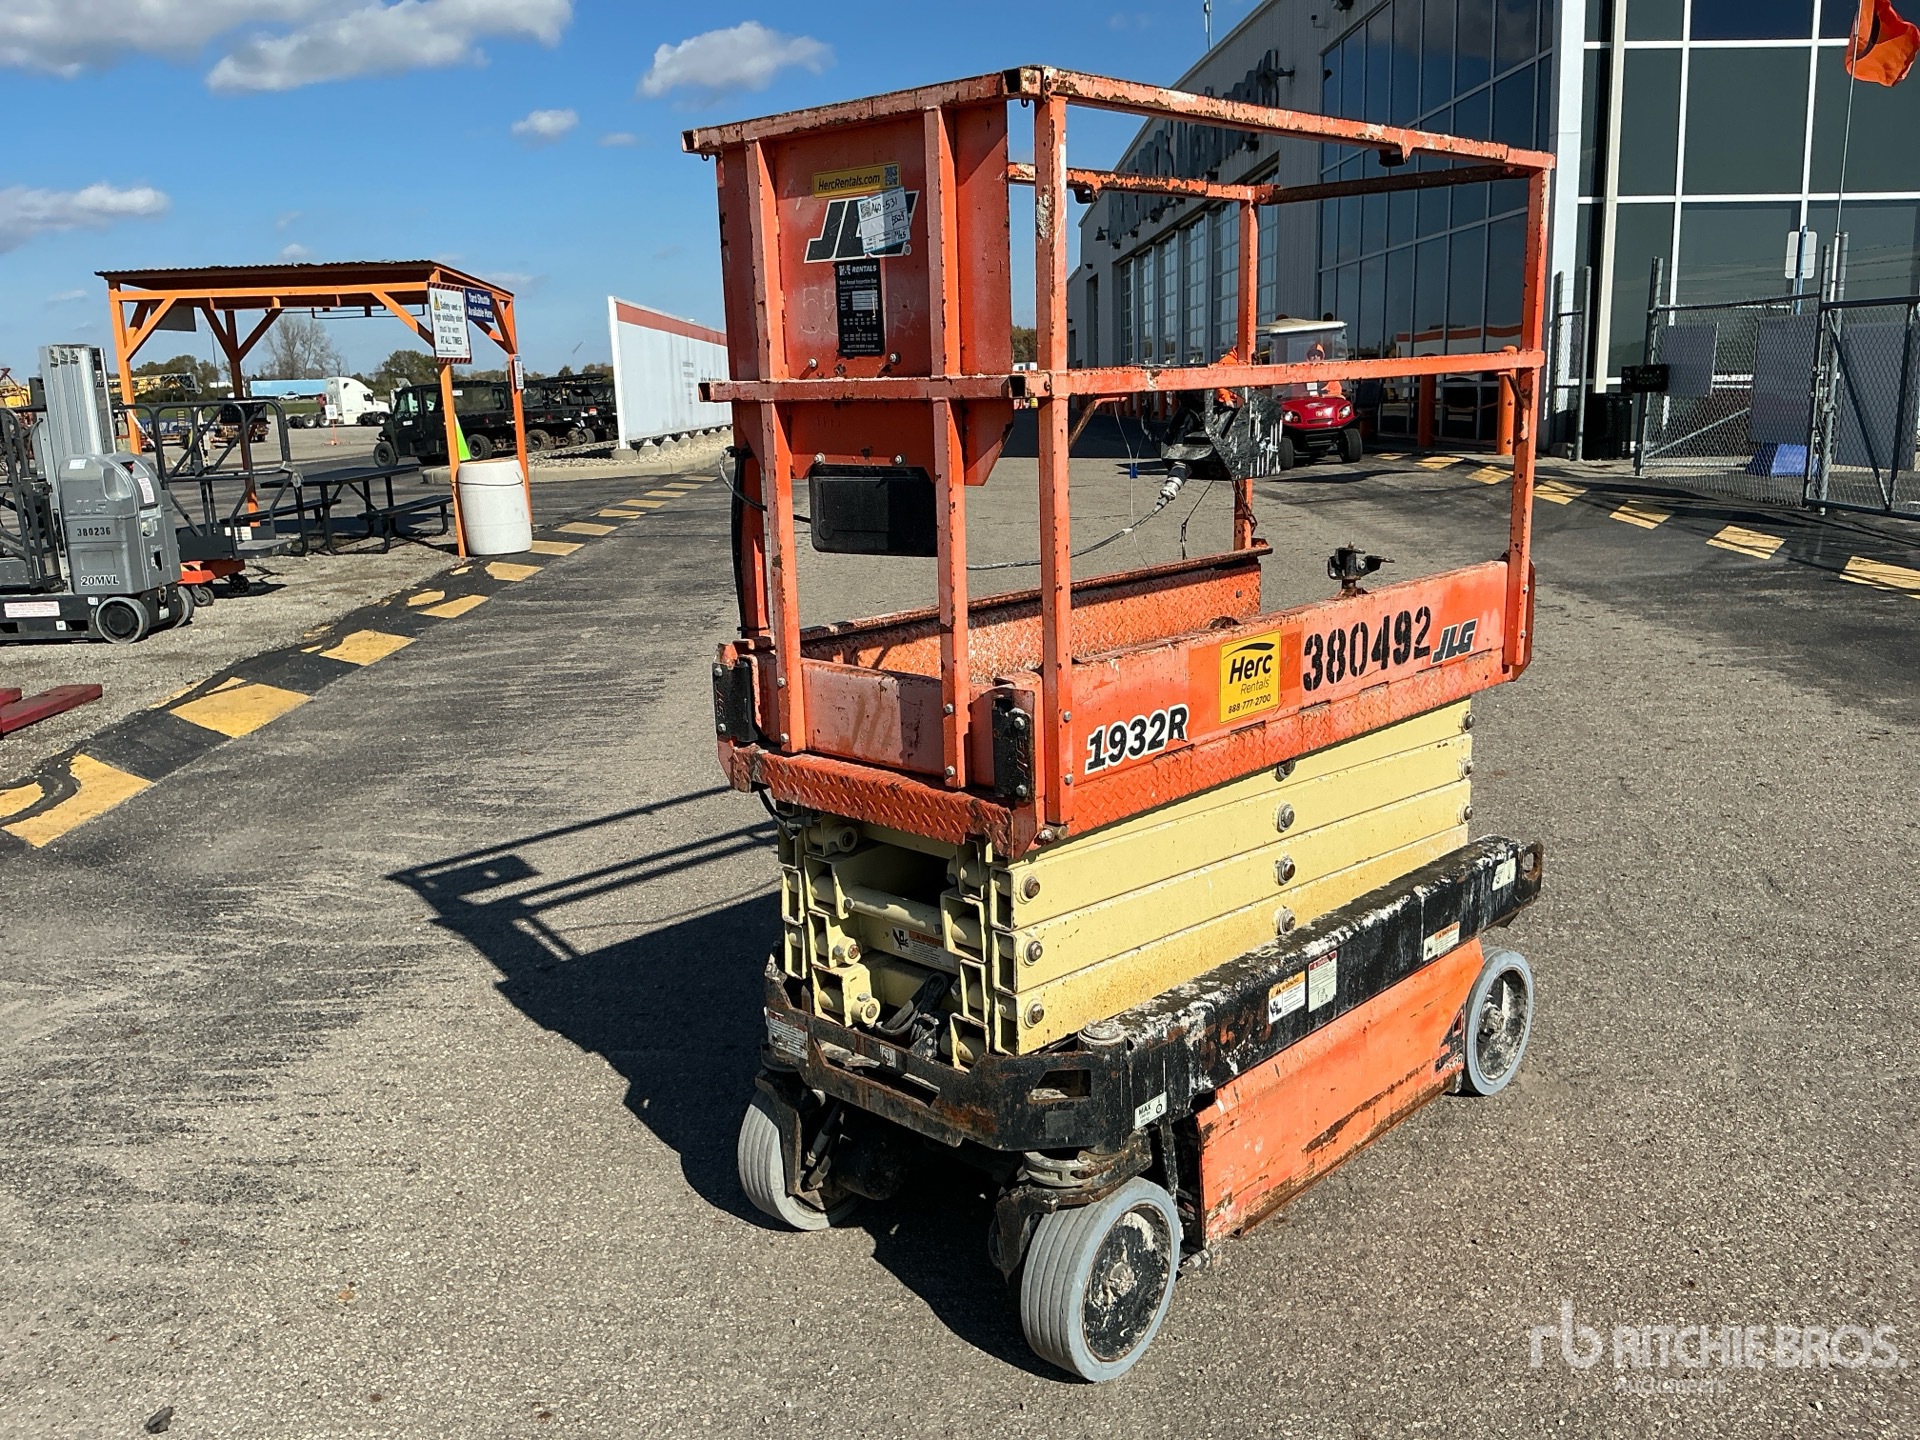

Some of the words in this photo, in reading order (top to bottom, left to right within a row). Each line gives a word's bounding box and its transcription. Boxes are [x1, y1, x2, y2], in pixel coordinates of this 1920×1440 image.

[818, 174, 880, 190] HercRentals.com
[851, 264, 877, 273] RENTALS
[468, 306, 484, 318] Available
[76, 527, 112, 538] 380236
[81, 575, 119, 587] 20MVL
[1302, 605, 1432, 692] 380492
[1430, 618, 1479, 665] JLG
[1228, 654, 1273, 685] Herc
[1240, 676, 1270, 695] Rentals
[1228, 693, 1272, 714] 888-777-2700
[1085, 704, 1189, 775] 1932R
[1138, 1103, 1151, 1116] MAX
